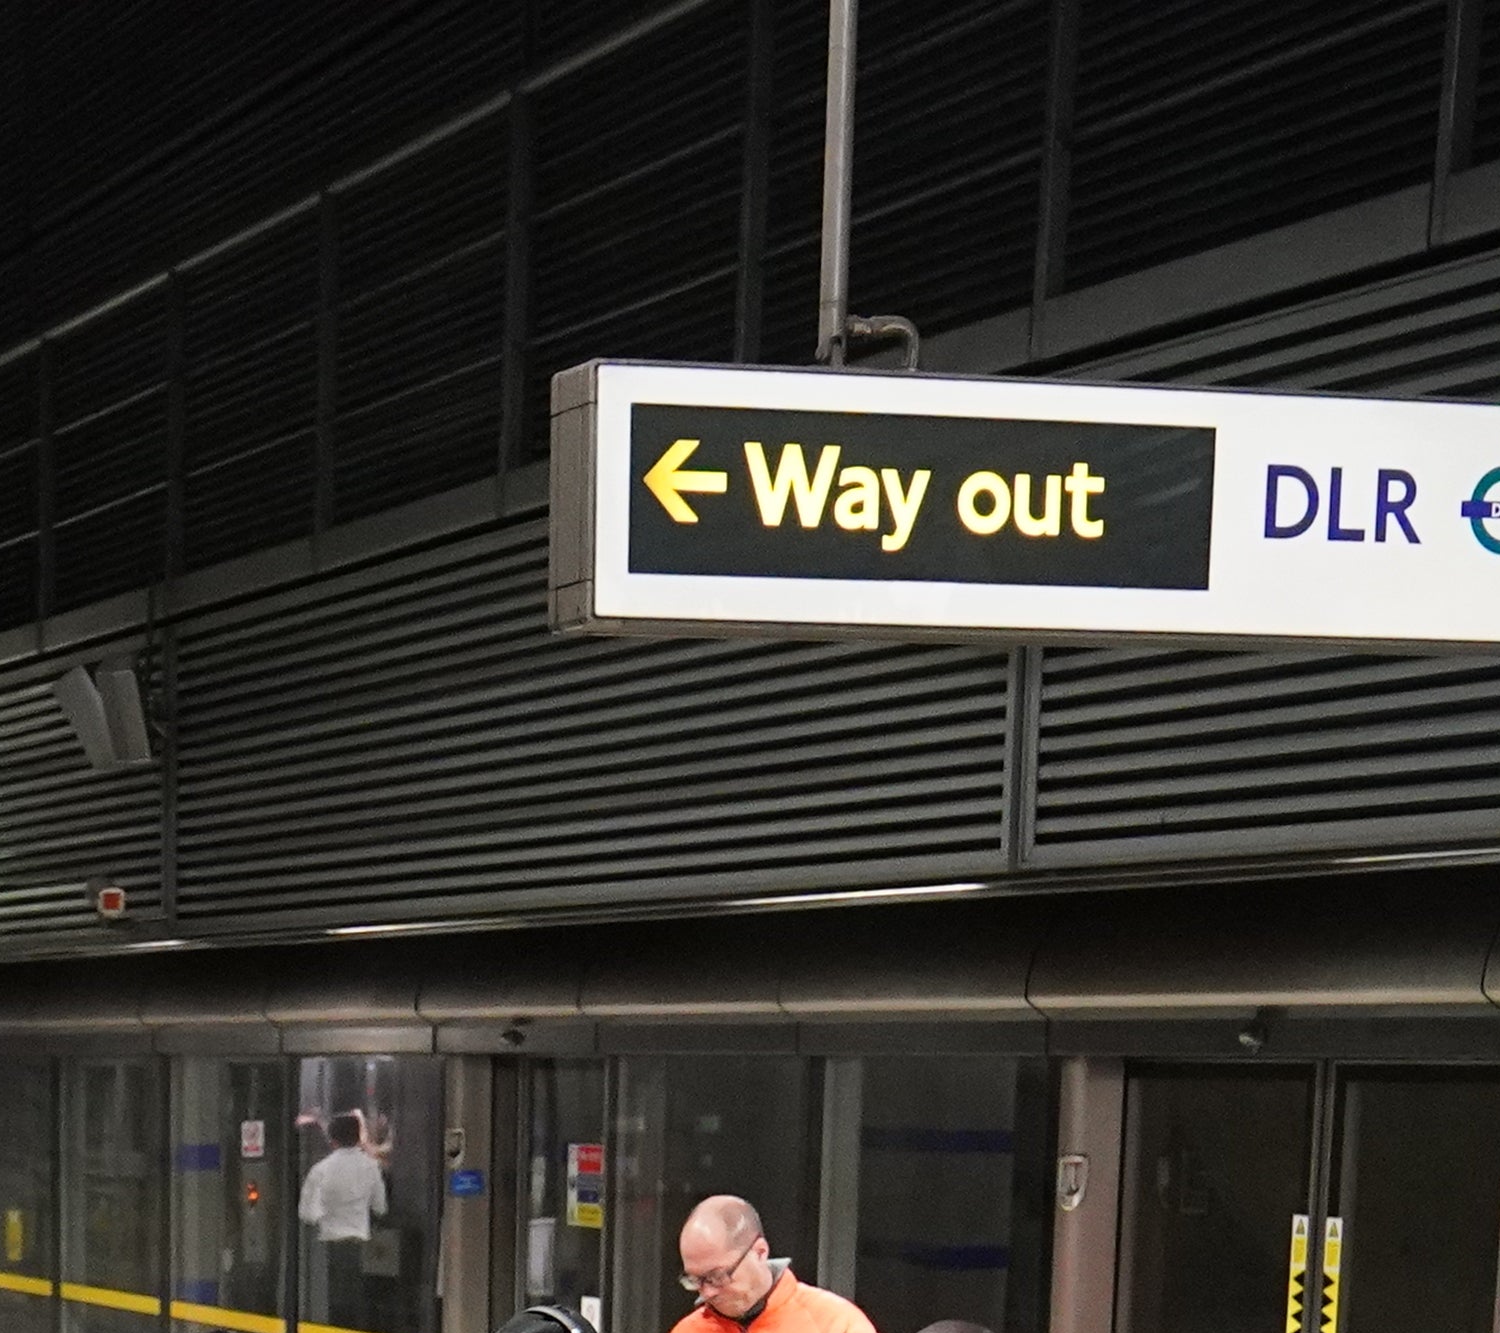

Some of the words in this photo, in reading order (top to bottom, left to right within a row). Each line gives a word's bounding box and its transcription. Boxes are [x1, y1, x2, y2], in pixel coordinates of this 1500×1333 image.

[743, 441, 932, 552] Way
[957, 462, 1106, 539] out
[1264, 464, 1422, 544] DLR
